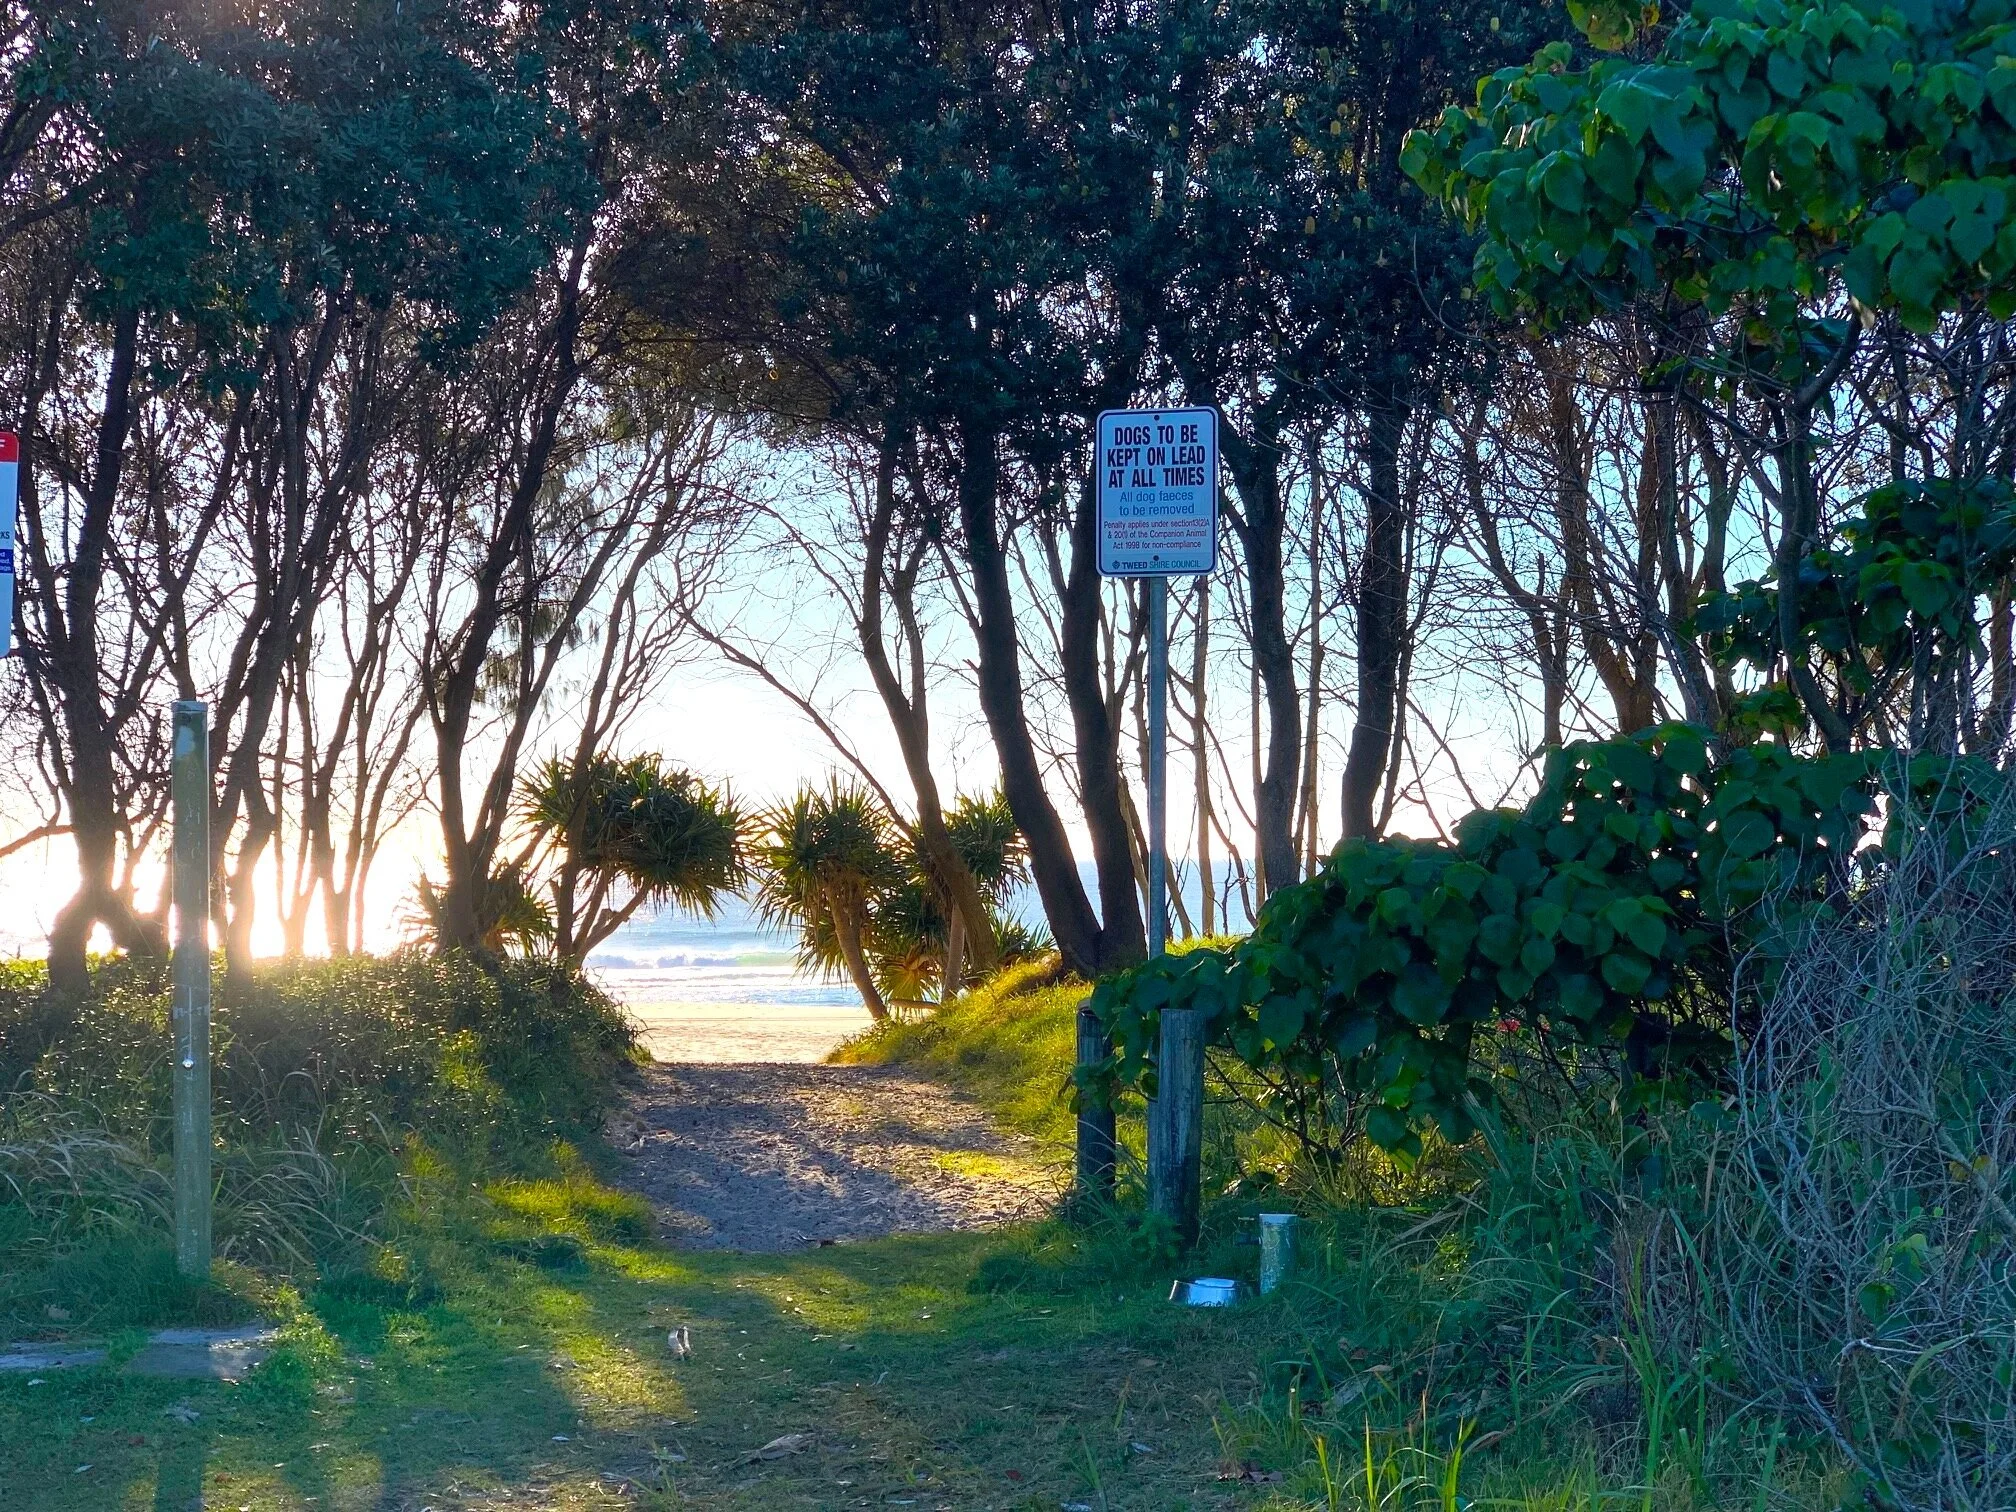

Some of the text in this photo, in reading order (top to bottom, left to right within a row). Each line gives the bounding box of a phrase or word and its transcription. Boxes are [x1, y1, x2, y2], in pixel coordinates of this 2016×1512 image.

[1115, 425, 1198, 445] DOGS TO BE
[1108, 446, 1205, 467] KEPT ON LEAD
[1109, 467, 1204, 488] AT ALL TIMES
[1120, 490, 1193, 503] All dog faeces
[1119, 503, 1194, 515] to be removed
[1104, 520, 1126, 529] Penalty
[1128, 520, 1149, 529] applies
[1108, 531, 1112, 539] &
[1130, 530, 1136, 538] of
[1150, 529, 1184, 539] Companion
[1125, 541, 1140, 549] 1998
[1142, 541, 1150, 549] for
[1152, 541, 1201, 549] non-compliance
[1122, 560, 1201, 569] TWEED SHIRE COUNCIL
